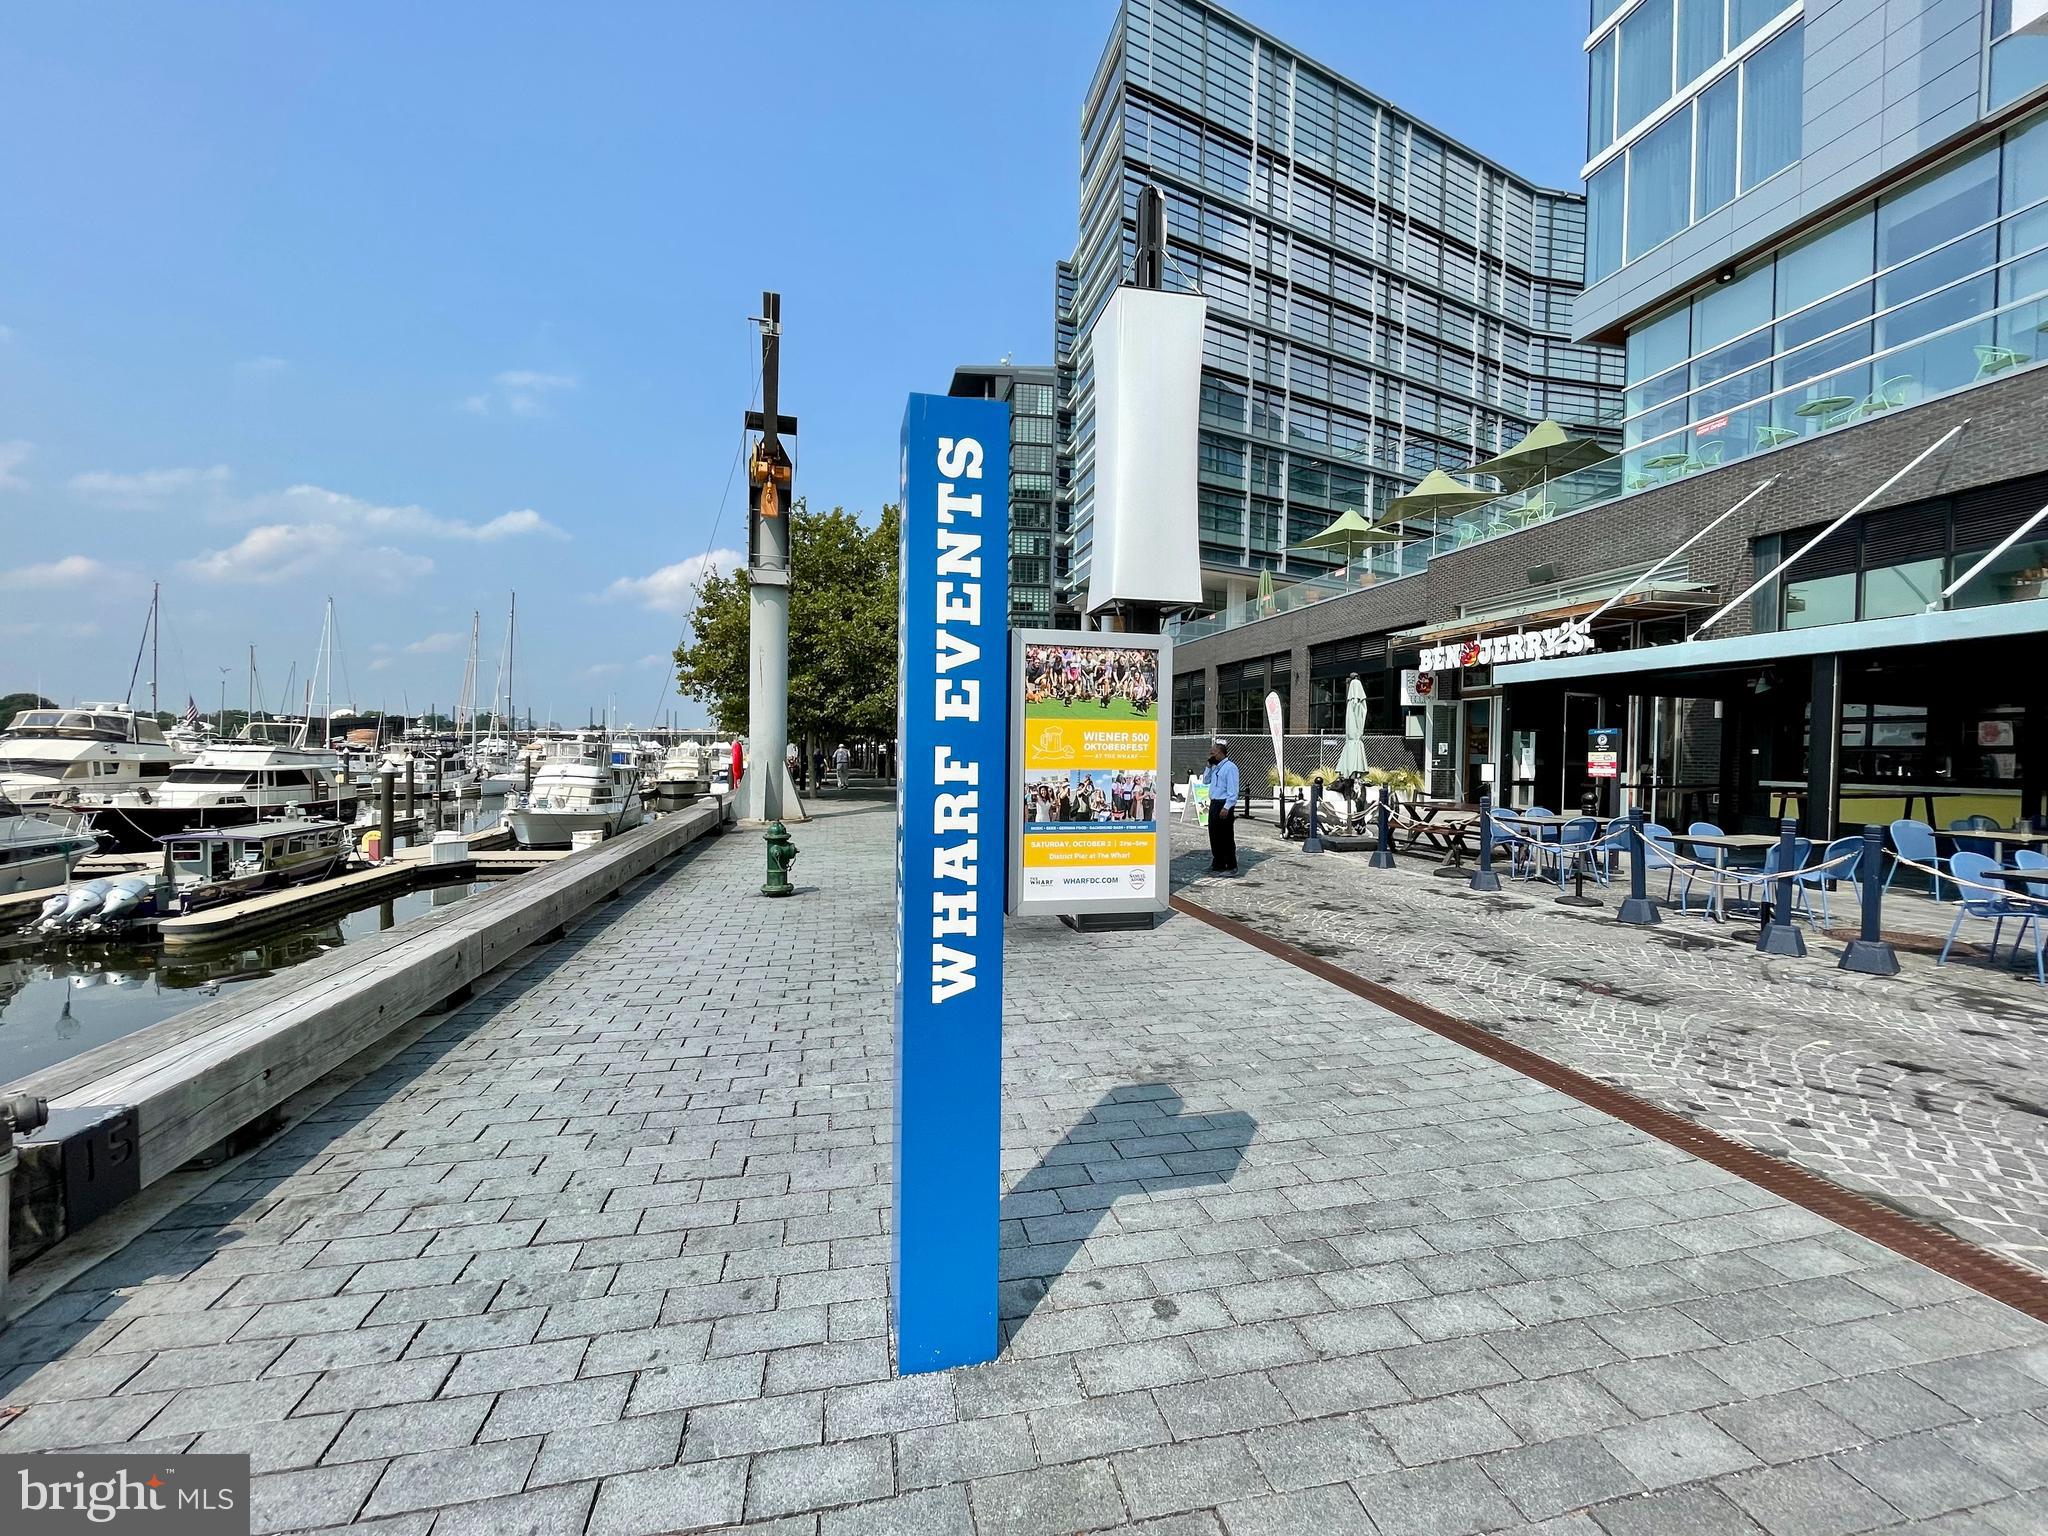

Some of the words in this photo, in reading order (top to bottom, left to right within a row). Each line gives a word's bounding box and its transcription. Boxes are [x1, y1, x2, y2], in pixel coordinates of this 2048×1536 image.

[935, 437, 984, 722] EVENTS
[1419, 643, 1461, 672] BEN
[1478, 621, 1588, 666] JERRY'S
[1084, 731, 1129, 742] WIENER
[1132, 732, 1150, 743] 500
[1083, 742, 1149, 751] OKTOBERFEST
[1072, 840, 1106, 848] OCTOBER
[1049, 852, 1073, 860] District
[1098, 851, 1109, 859] The
[1110, 851, 1130, 859] Wharf
[931, 746, 979, 1004] WHARF
[1063, 876, 1119, 885] WHARFDC.COM
[85, 1117, 133, 1182] 15
